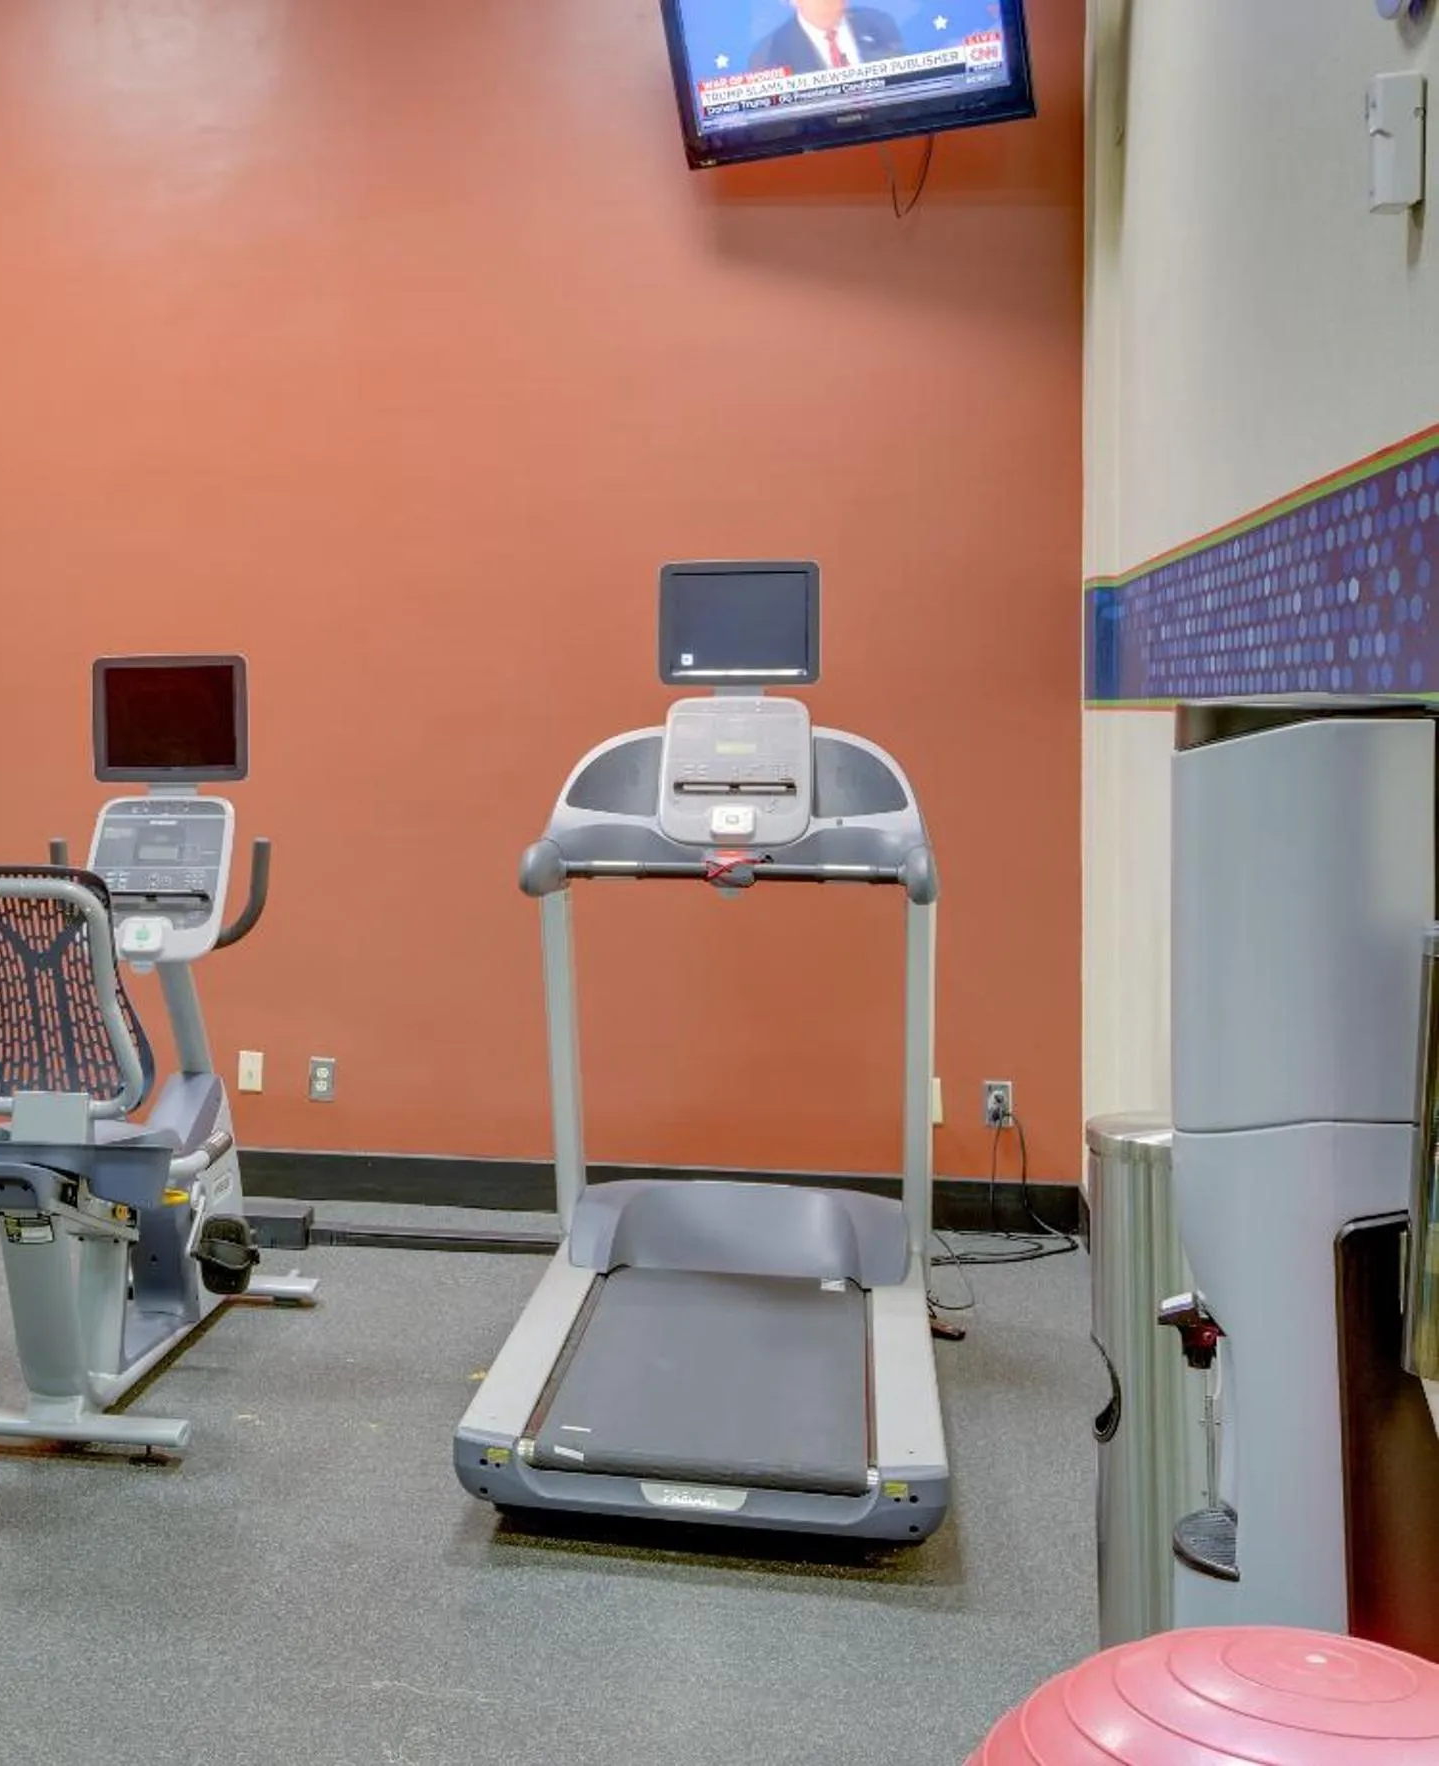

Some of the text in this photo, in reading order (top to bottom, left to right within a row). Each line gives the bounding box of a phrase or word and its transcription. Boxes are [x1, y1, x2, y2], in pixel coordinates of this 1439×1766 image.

[970, 47, 999, 63] CNN
[705, 88, 744, 103] TRUMP
[746, 82, 782, 97] SLAMS
[813, 64, 888, 84] NEWSPAPER
[891, 50, 959, 73] PUBLISHER
[742, 97, 771, 111] Trump
